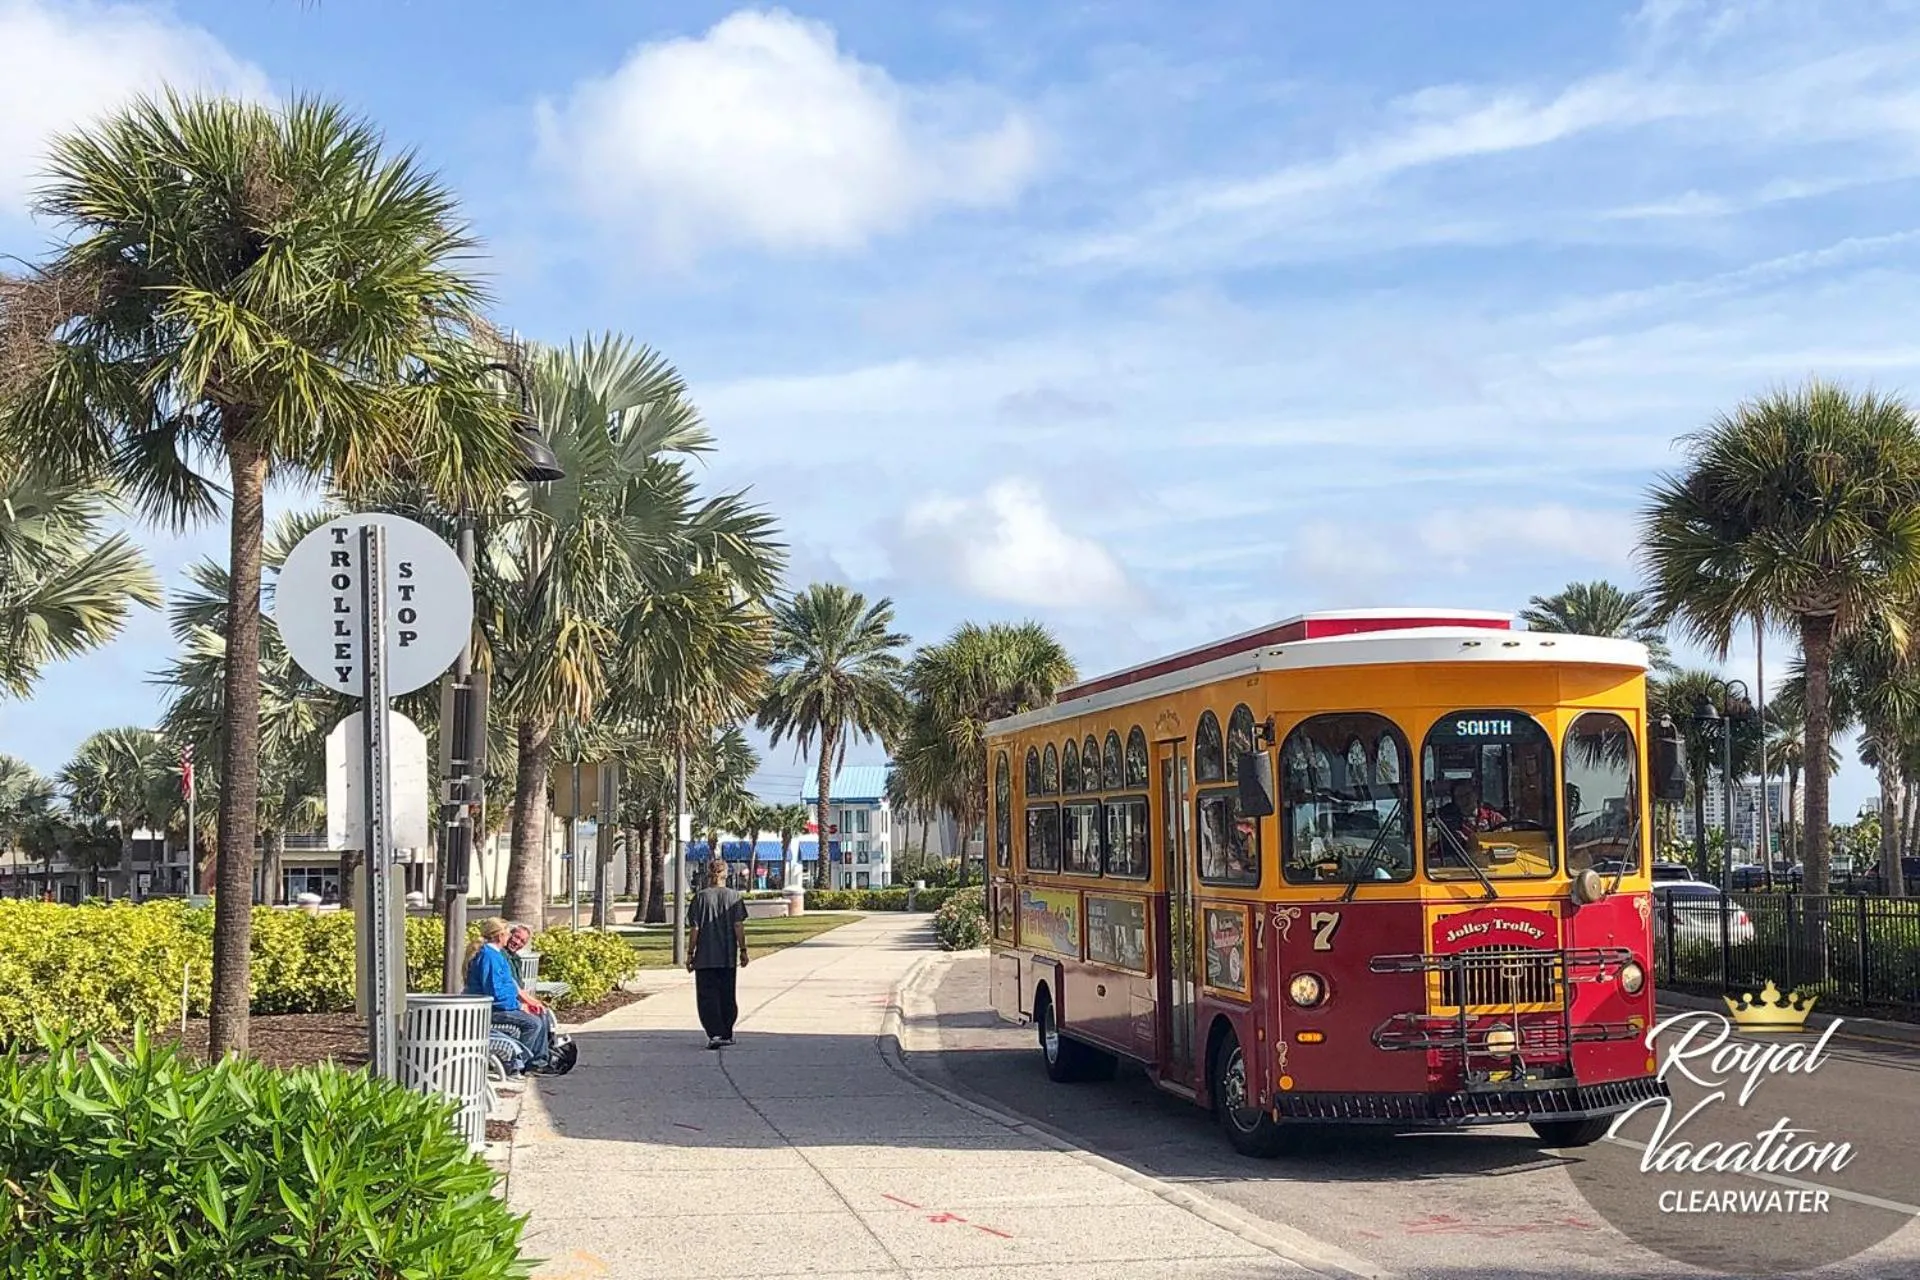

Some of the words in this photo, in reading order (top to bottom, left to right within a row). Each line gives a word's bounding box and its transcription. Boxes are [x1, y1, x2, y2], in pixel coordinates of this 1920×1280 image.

[330, 528, 353, 683] TROLLEY
[397, 562, 418, 647] STOP
[1456, 719, 1512, 736] SOUTH
[1343, 845, 1400, 867] Troley
[1255, 911, 1266, 949] 7
[1310, 911, 1340, 950] 7
[1446, 921, 1490, 942] Jolley
[1493, 918, 1545, 940] Trolley
